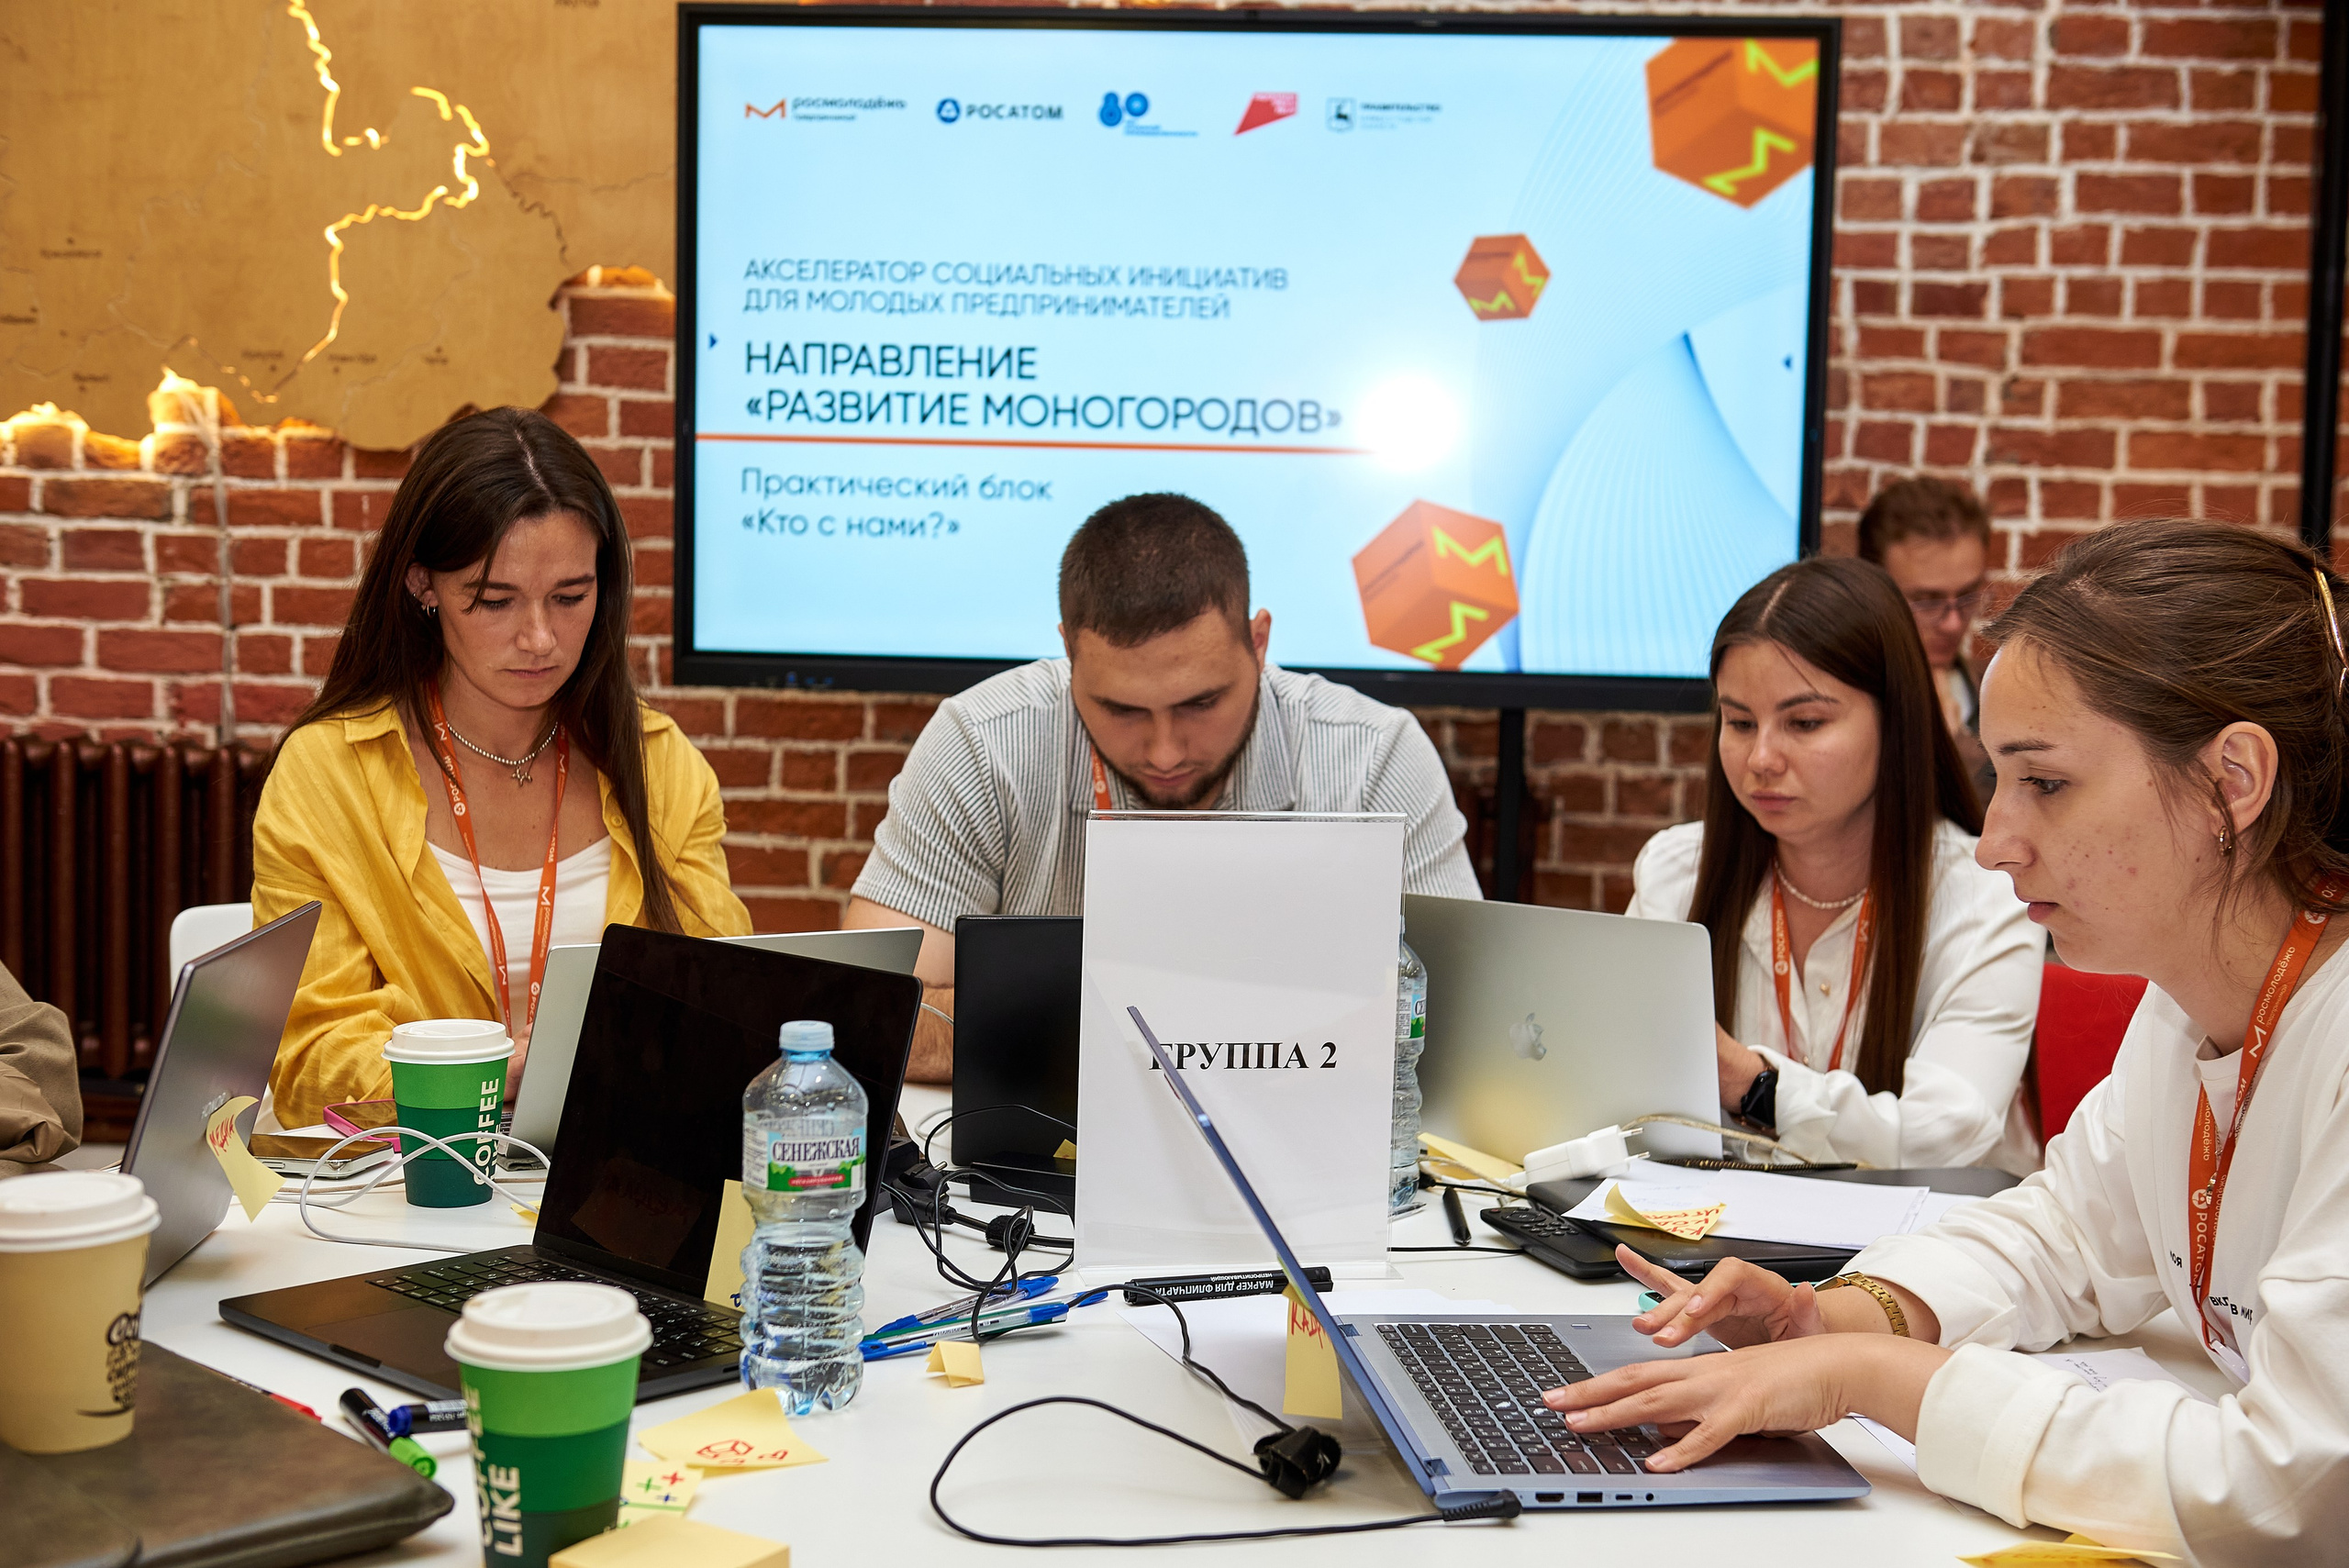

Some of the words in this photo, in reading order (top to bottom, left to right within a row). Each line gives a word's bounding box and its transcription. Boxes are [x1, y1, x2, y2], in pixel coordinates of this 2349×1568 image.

[967, 104, 1063, 120] РОСАТОМ
[743, 259, 925, 284] АКСЕЛЕРАТОР
[932, 261, 1120, 288] СОЦИАЛЬНЫХ
[1128, 265, 1288, 291] ИНИЦИАТИВ
[742, 289, 799, 314] ДЛЯ
[806, 290, 944, 317] МОЛОДЫХ
[952, 292, 1230, 320] ПРЕДПРИНИМАТЕЛЕЙ
[745, 341, 1038, 380] НАПРАВЛЕНИЕ
[745, 390, 969, 427] «РАЗВИТИЕ
[984, 394, 1342, 436] МОНОГОРОДОВ»
[741, 468, 969, 501] Практический
[979, 473, 1052, 501] блок
[741, 510, 807, 537] «Кто
[818, 517, 837, 536] с
[847, 511, 960, 539] нами?»
[2256, 945, 2296, 1025] росмолодёжь
[527, 995, 537, 1024] РОСА
[1319, 1041, 1338, 1069] 2
[473, 1077, 499, 1185] COFFEE
[772, 1137, 861, 1162] СЕНЕЖСКАЯ
[2193, 1211, 2208, 1285] РОСАТОМ
[1154, 1283, 1214, 1296] ФЛИПЧАРТА
[1215, 1281, 1235, 1292] ДЛЯ
[1236, 1279, 1275, 1290] МАРКЕР
[487, 1463, 524, 1557] LIKE
